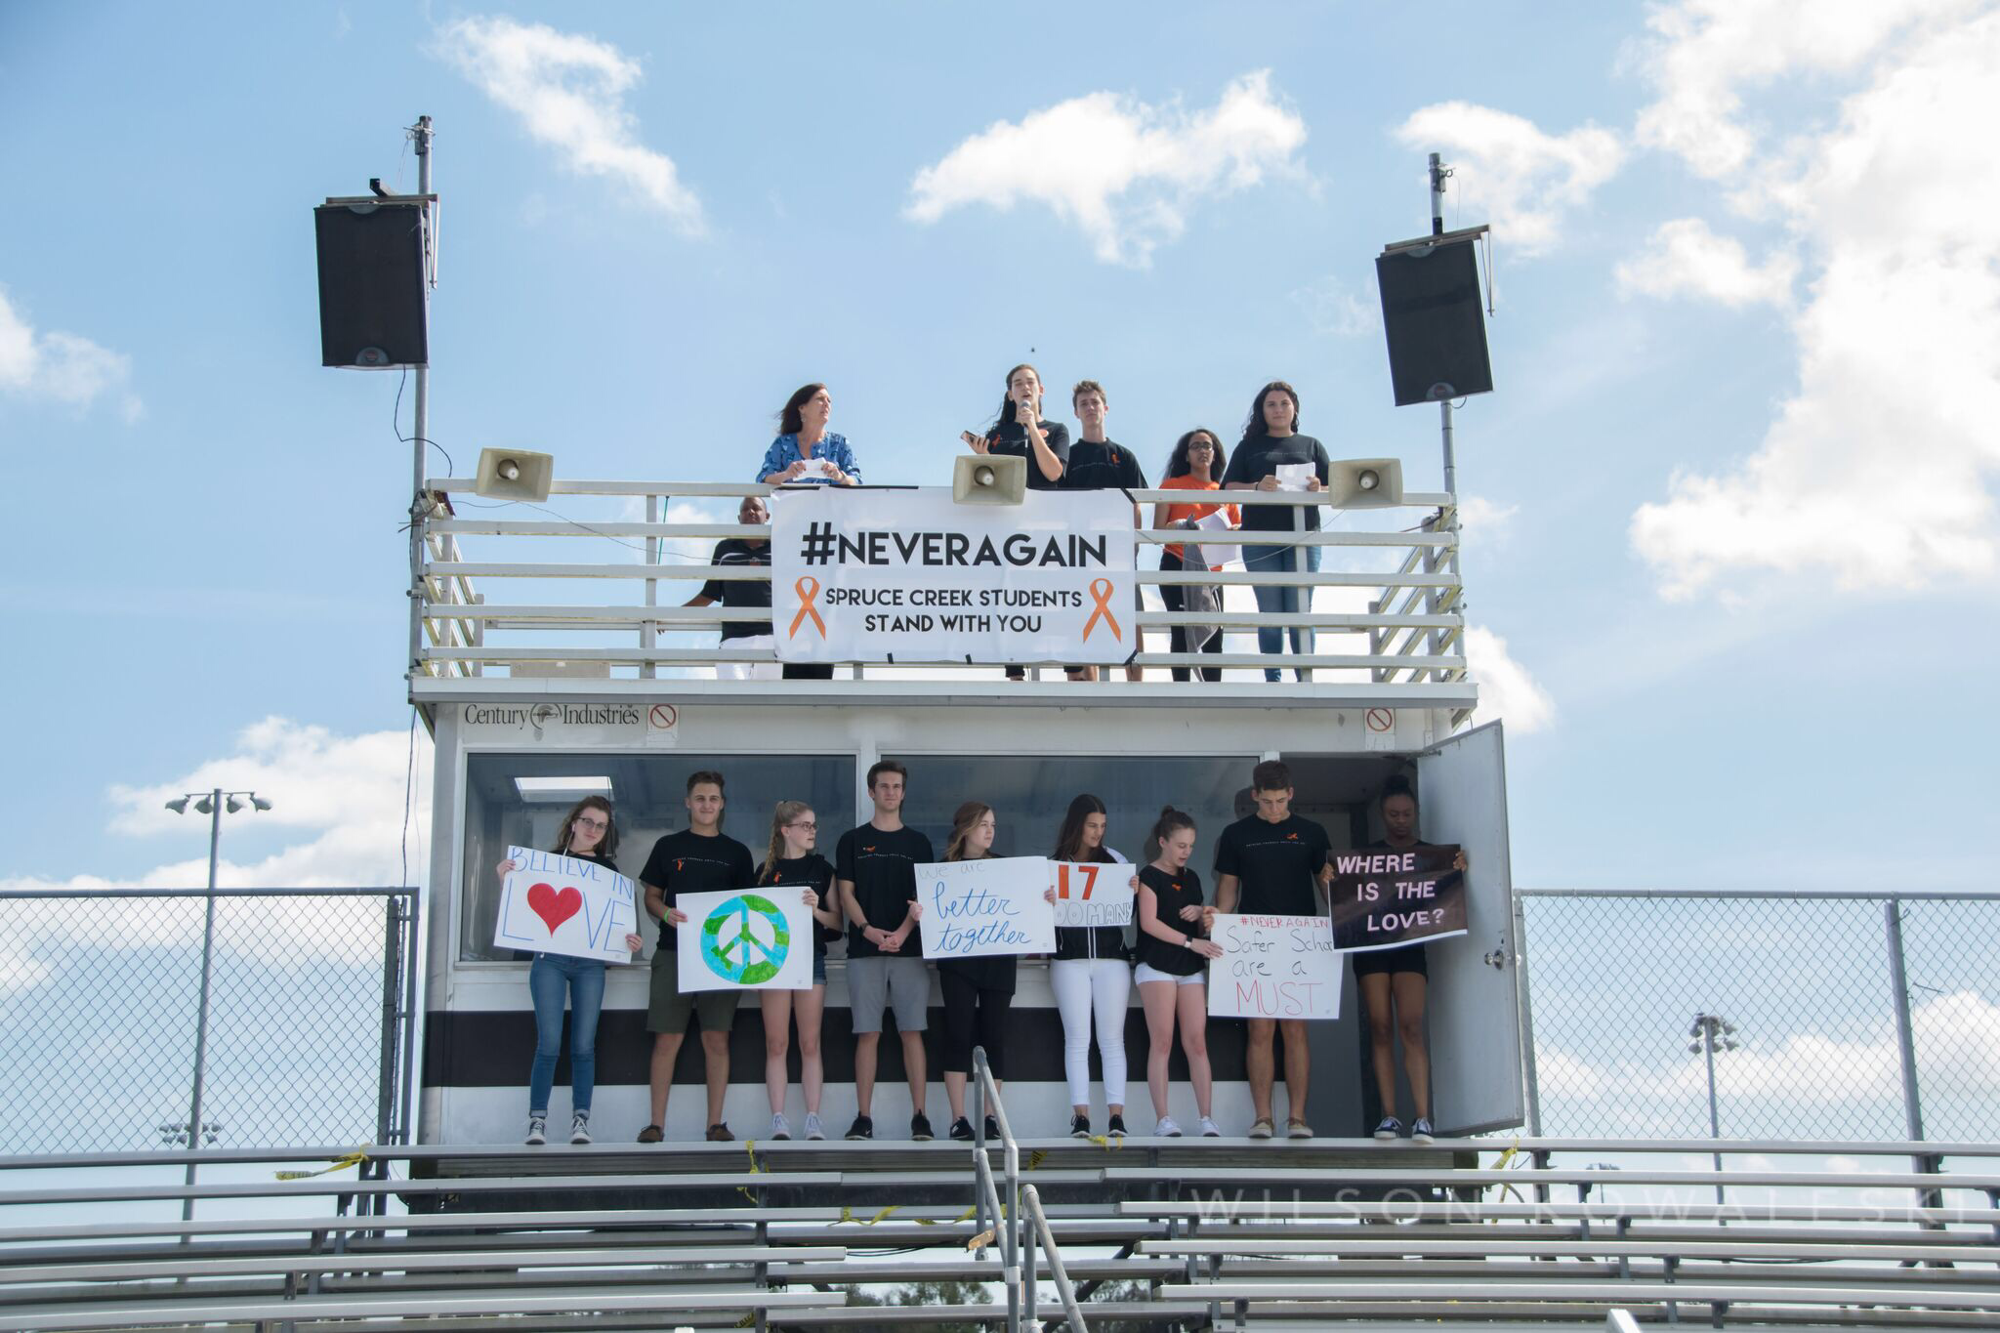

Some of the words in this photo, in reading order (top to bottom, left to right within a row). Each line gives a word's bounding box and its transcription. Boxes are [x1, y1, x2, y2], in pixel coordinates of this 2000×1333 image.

[800, 521, 1107, 567] #NEVERAGAIN
[825, 587, 904, 607] SPRUCE
[909, 588, 973, 607] CREEK
[979, 588, 1082, 608] STUDENTS
[865, 614, 934, 633] STAND
[939, 614, 991, 633] WITH
[996, 615, 1042, 633] YOU
[465, 703, 529, 730] Century
[563, 703, 639, 725] Industries
[1336, 852, 1415, 875] WHERE
[612, 872, 633, 900] IN
[1058, 864, 1100, 900] 17
[1357, 882, 1379, 902] IS
[1395, 880, 1436, 900] THE
[932, 881, 1020, 919] better
[1053, 901, 1084, 926] OO
[1366, 907, 1445, 932] LOVE?
[932, 920, 1031, 953] together
[1226, 925, 1275, 954] Safer
[1232, 959, 1272, 977] are
[1291, 960, 1307, 976] a
[1236, 979, 1324, 1015] MUST
